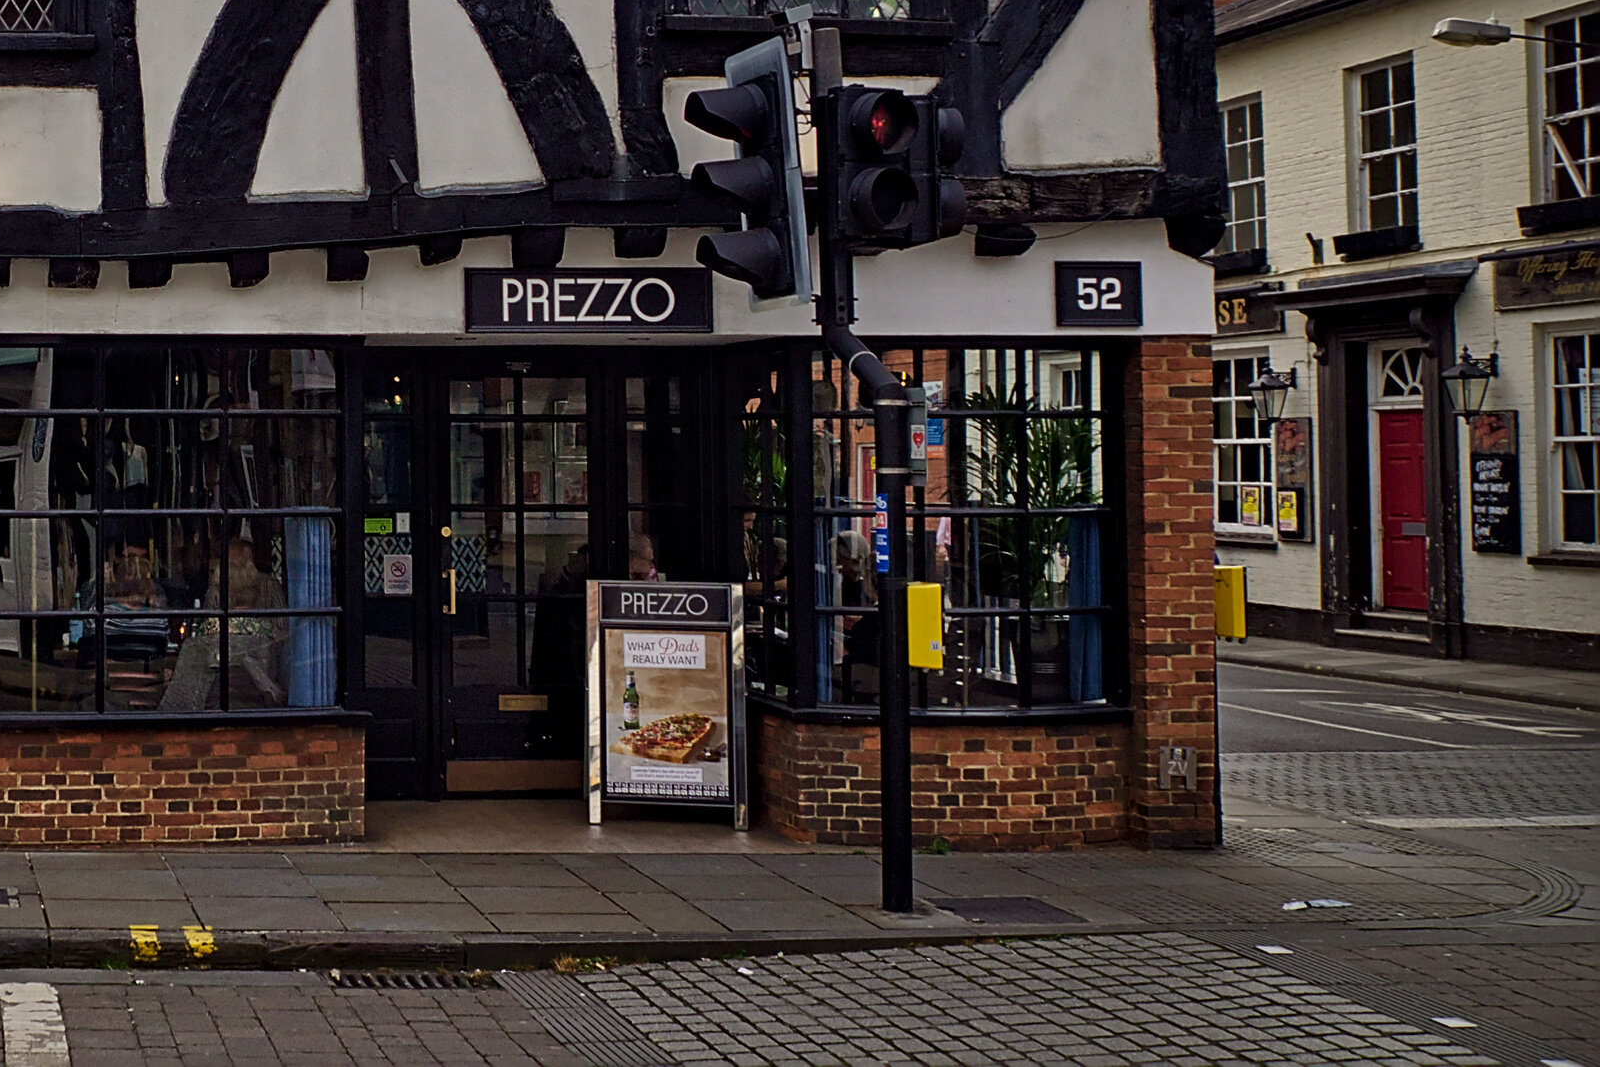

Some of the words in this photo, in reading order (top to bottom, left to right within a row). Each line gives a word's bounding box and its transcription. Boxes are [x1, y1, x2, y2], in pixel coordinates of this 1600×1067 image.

[1518, 255, 1569, 283] Offering
[501, 277, 676, 323] PREZZO
[1077, 277, 1122, 311] 52
[621, 592, 709, 616] PREZZO
[627, 642, 655, 651] WHAT
[658, 636, 699, 655] Dads
[632, 654, 665, 665] REALLY
[668, 656, 697, 665] WANT
